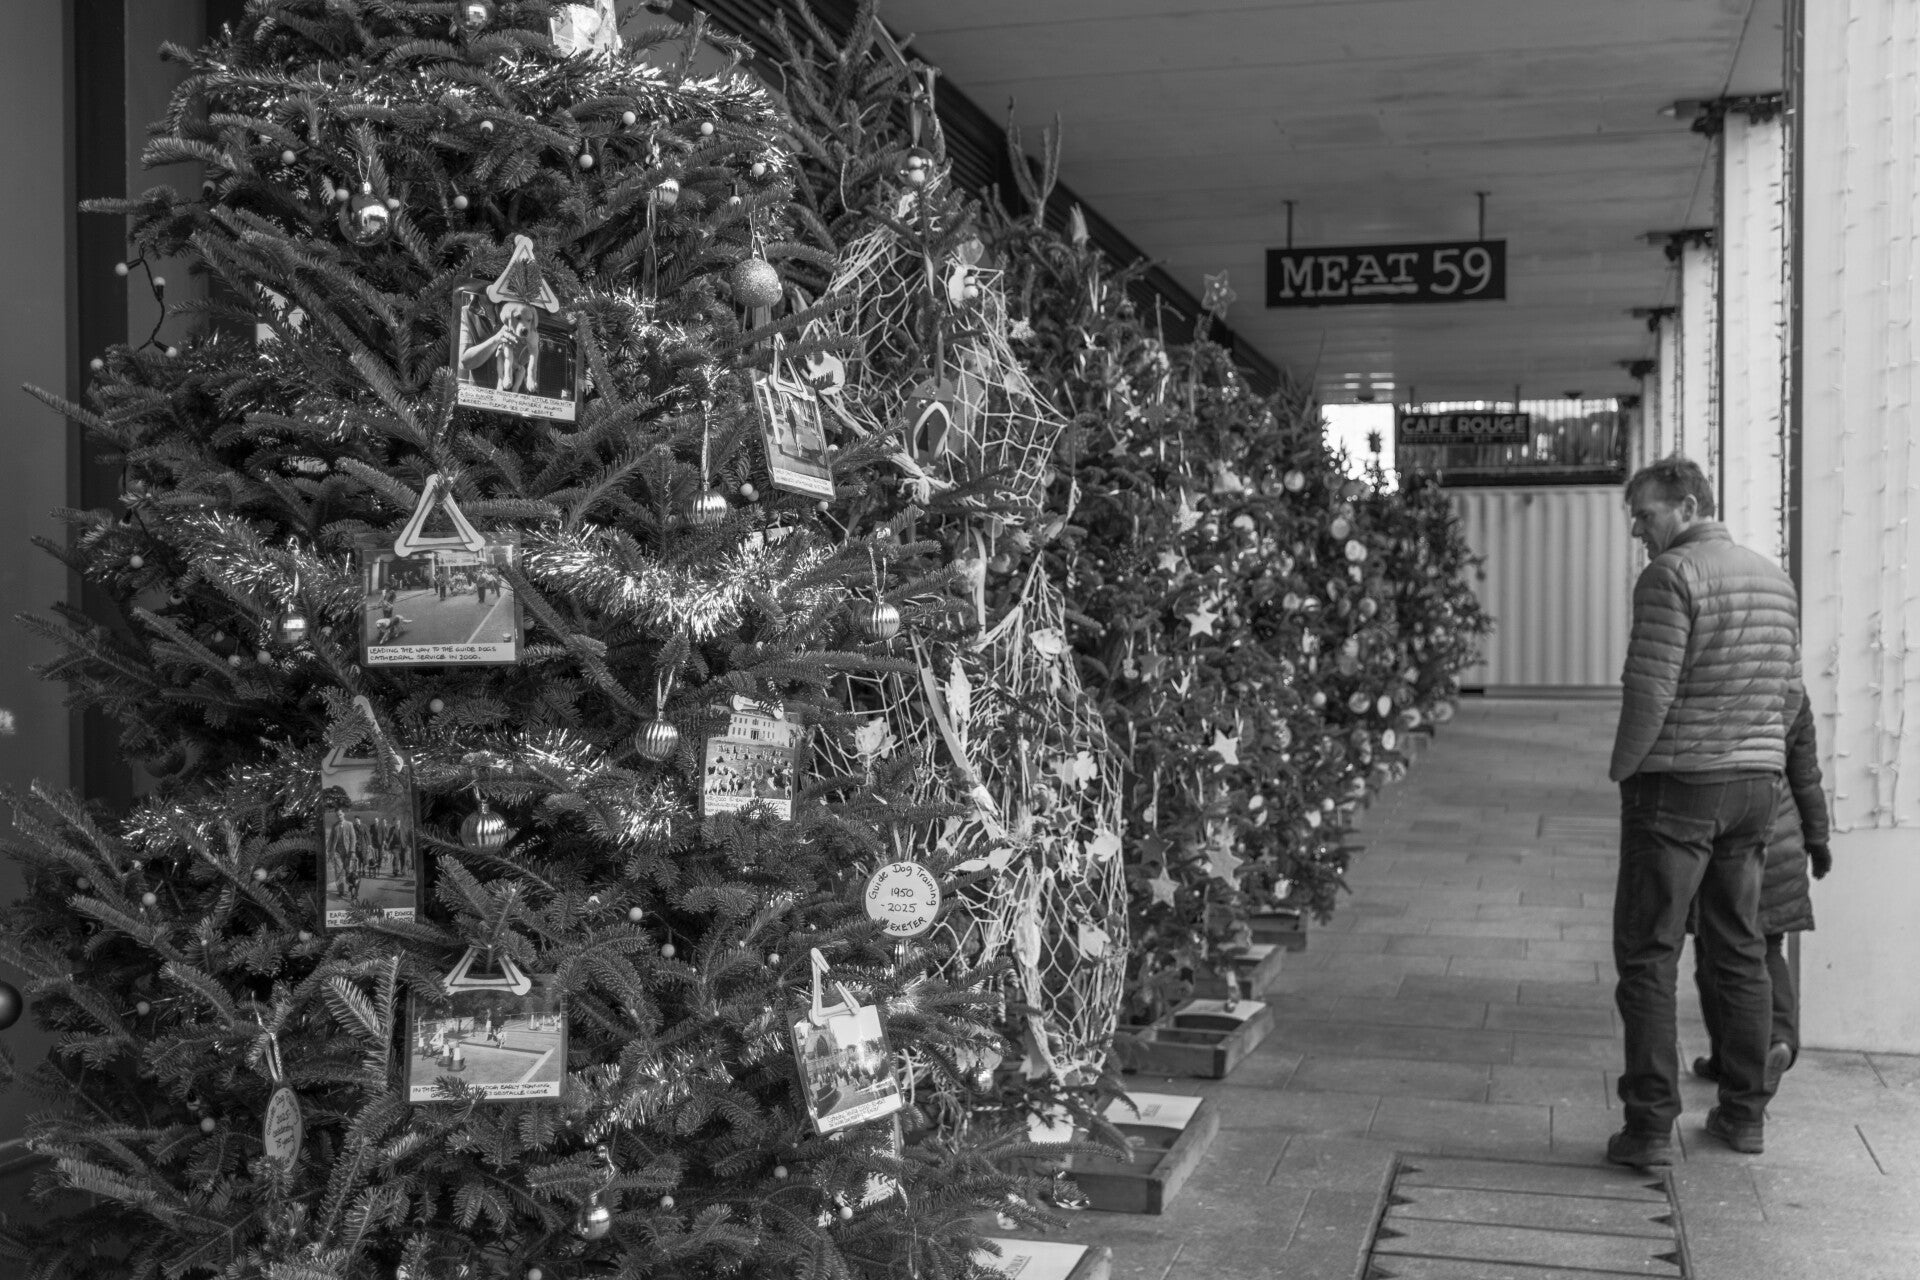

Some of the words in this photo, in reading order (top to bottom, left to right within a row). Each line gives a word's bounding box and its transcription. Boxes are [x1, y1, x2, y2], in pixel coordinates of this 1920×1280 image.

[1279, 252, 1419, 298] MEAT
[1430, 246, 1493, 295] 59
[1457, 415, 1527, 435] ROUGE
[868, 871, 889, 900] Guide
[892, 863, 913, 878] Dog
[916, 866, 937, 906] Training
[890, 887, 914, 898] 1950
[890, 916, 927, 932] EXETER
